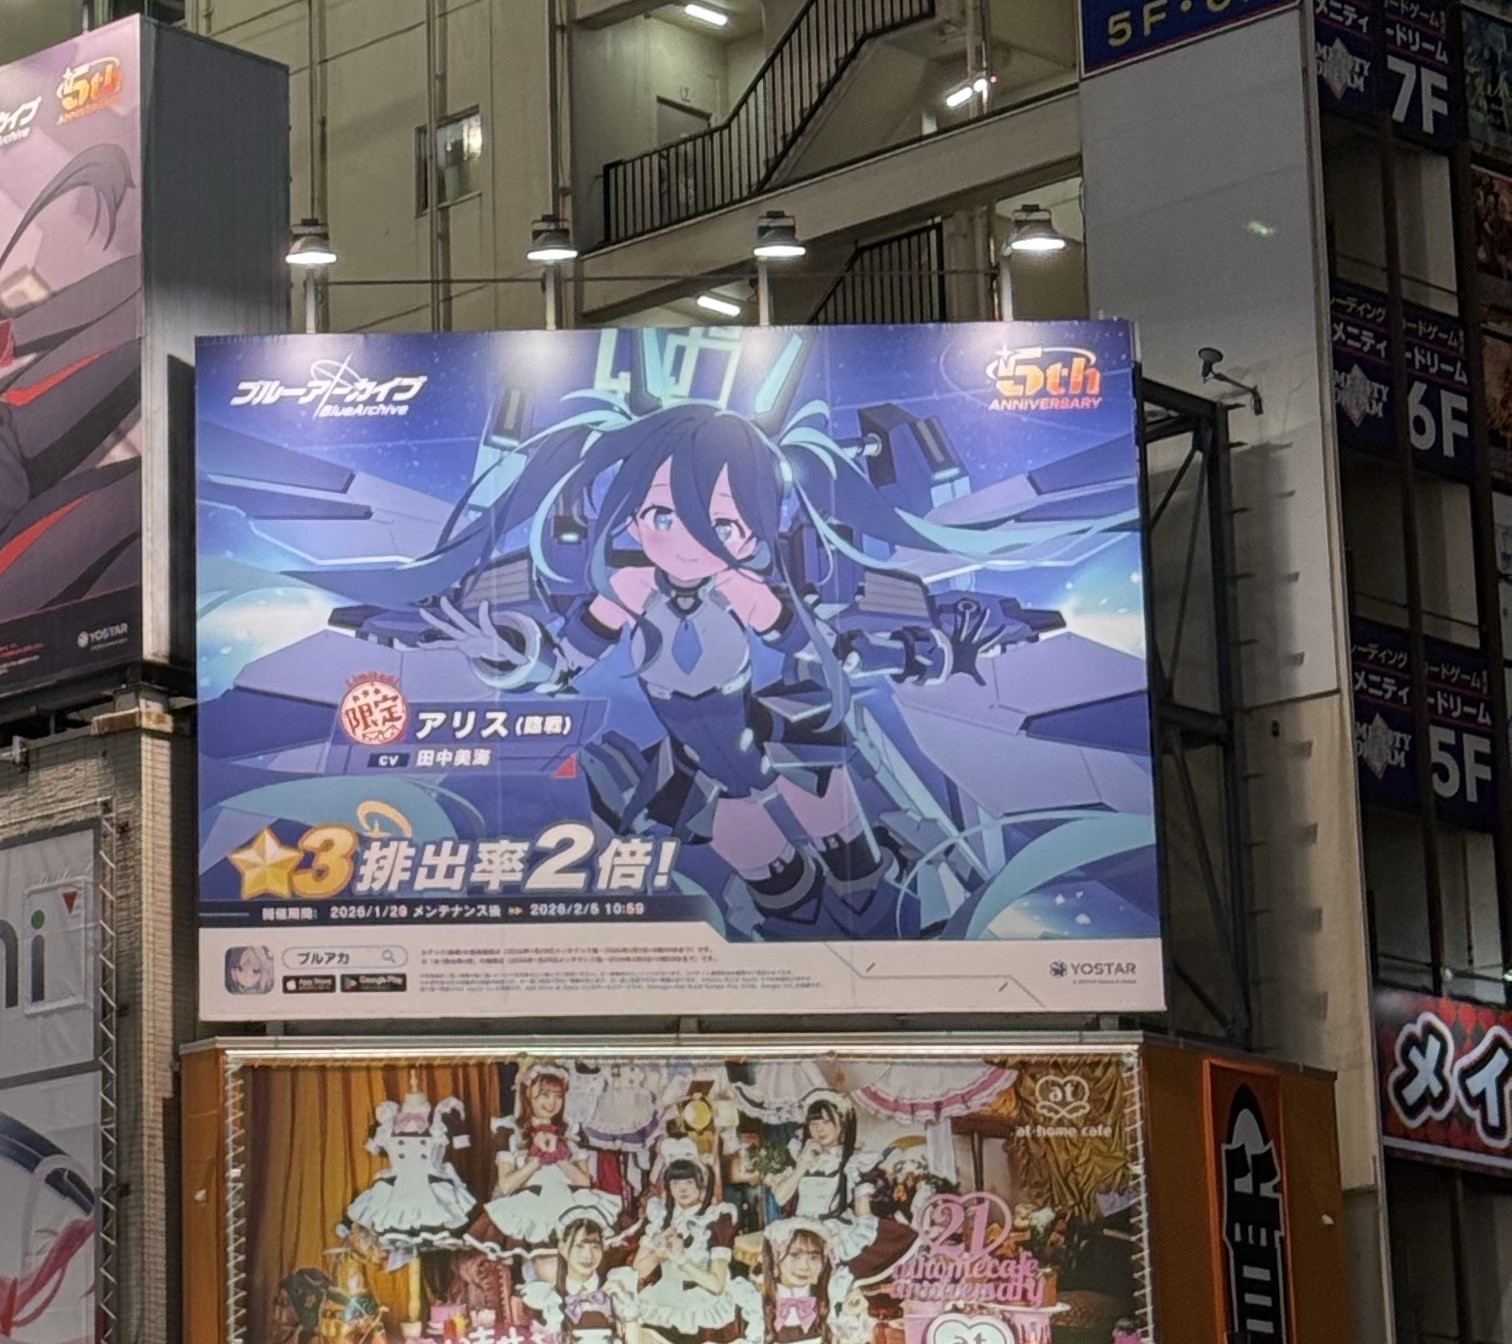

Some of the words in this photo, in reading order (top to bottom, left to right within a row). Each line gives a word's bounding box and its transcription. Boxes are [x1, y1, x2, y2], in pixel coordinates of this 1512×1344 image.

[1387, 54, 1448, 135] 7F
[230, 366, 428, 407] ブルーアーカイブ
[994, 346, 1101, 397] 5th
[989, 396, 1104, 411] ANNIVERSARY
[1408, 379, 1469, 459] 6F
[415, 710, 509, 740] アリス
[378, 754, 400, 767] CV
[1429, 723, 1492, 803] 5F
[413, 903, 502, 919] メンテナンス後
[604, 901, 645, 916] 10:59
[297, 952, 350, 966] ブルアカ
[1070, 962, 1136, 977] YOSTAR
[1393, 1018, 1512, 1143] メイ
[1081, 1124, 1112, 1138] cafe
[932, 1202, 990, 1256] 21
